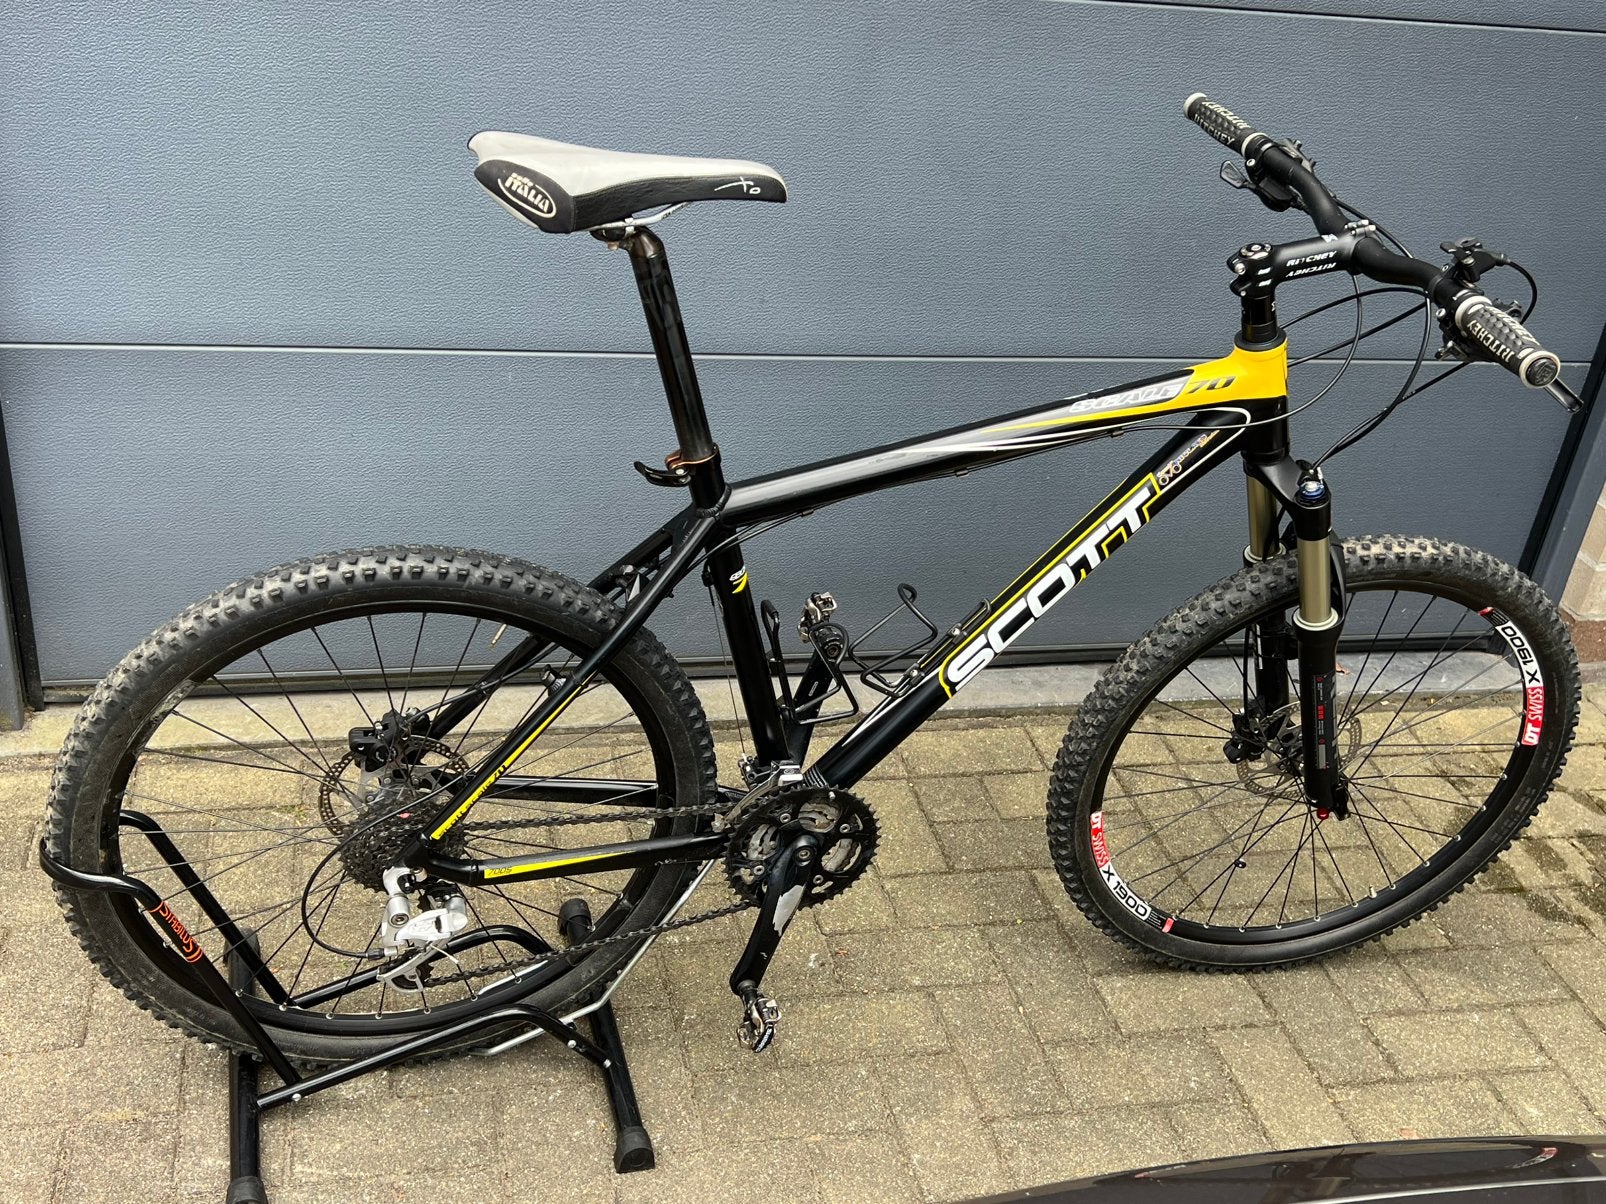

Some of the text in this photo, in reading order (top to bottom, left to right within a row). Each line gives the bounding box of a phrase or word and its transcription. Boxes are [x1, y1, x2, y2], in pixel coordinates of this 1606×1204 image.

[504, 176, 550, 213] ITALIA
[1187, 375, 1237, 395] 70
[946, 486, 1151, 693] SCOTT
[1501, 625, 1544, 745] DT SWISS X 1900
[1092, 831, 1110, 867] SWISS
[1102, 864, 1115, 883] X
[1112, 880, 1147, 917] 1900
